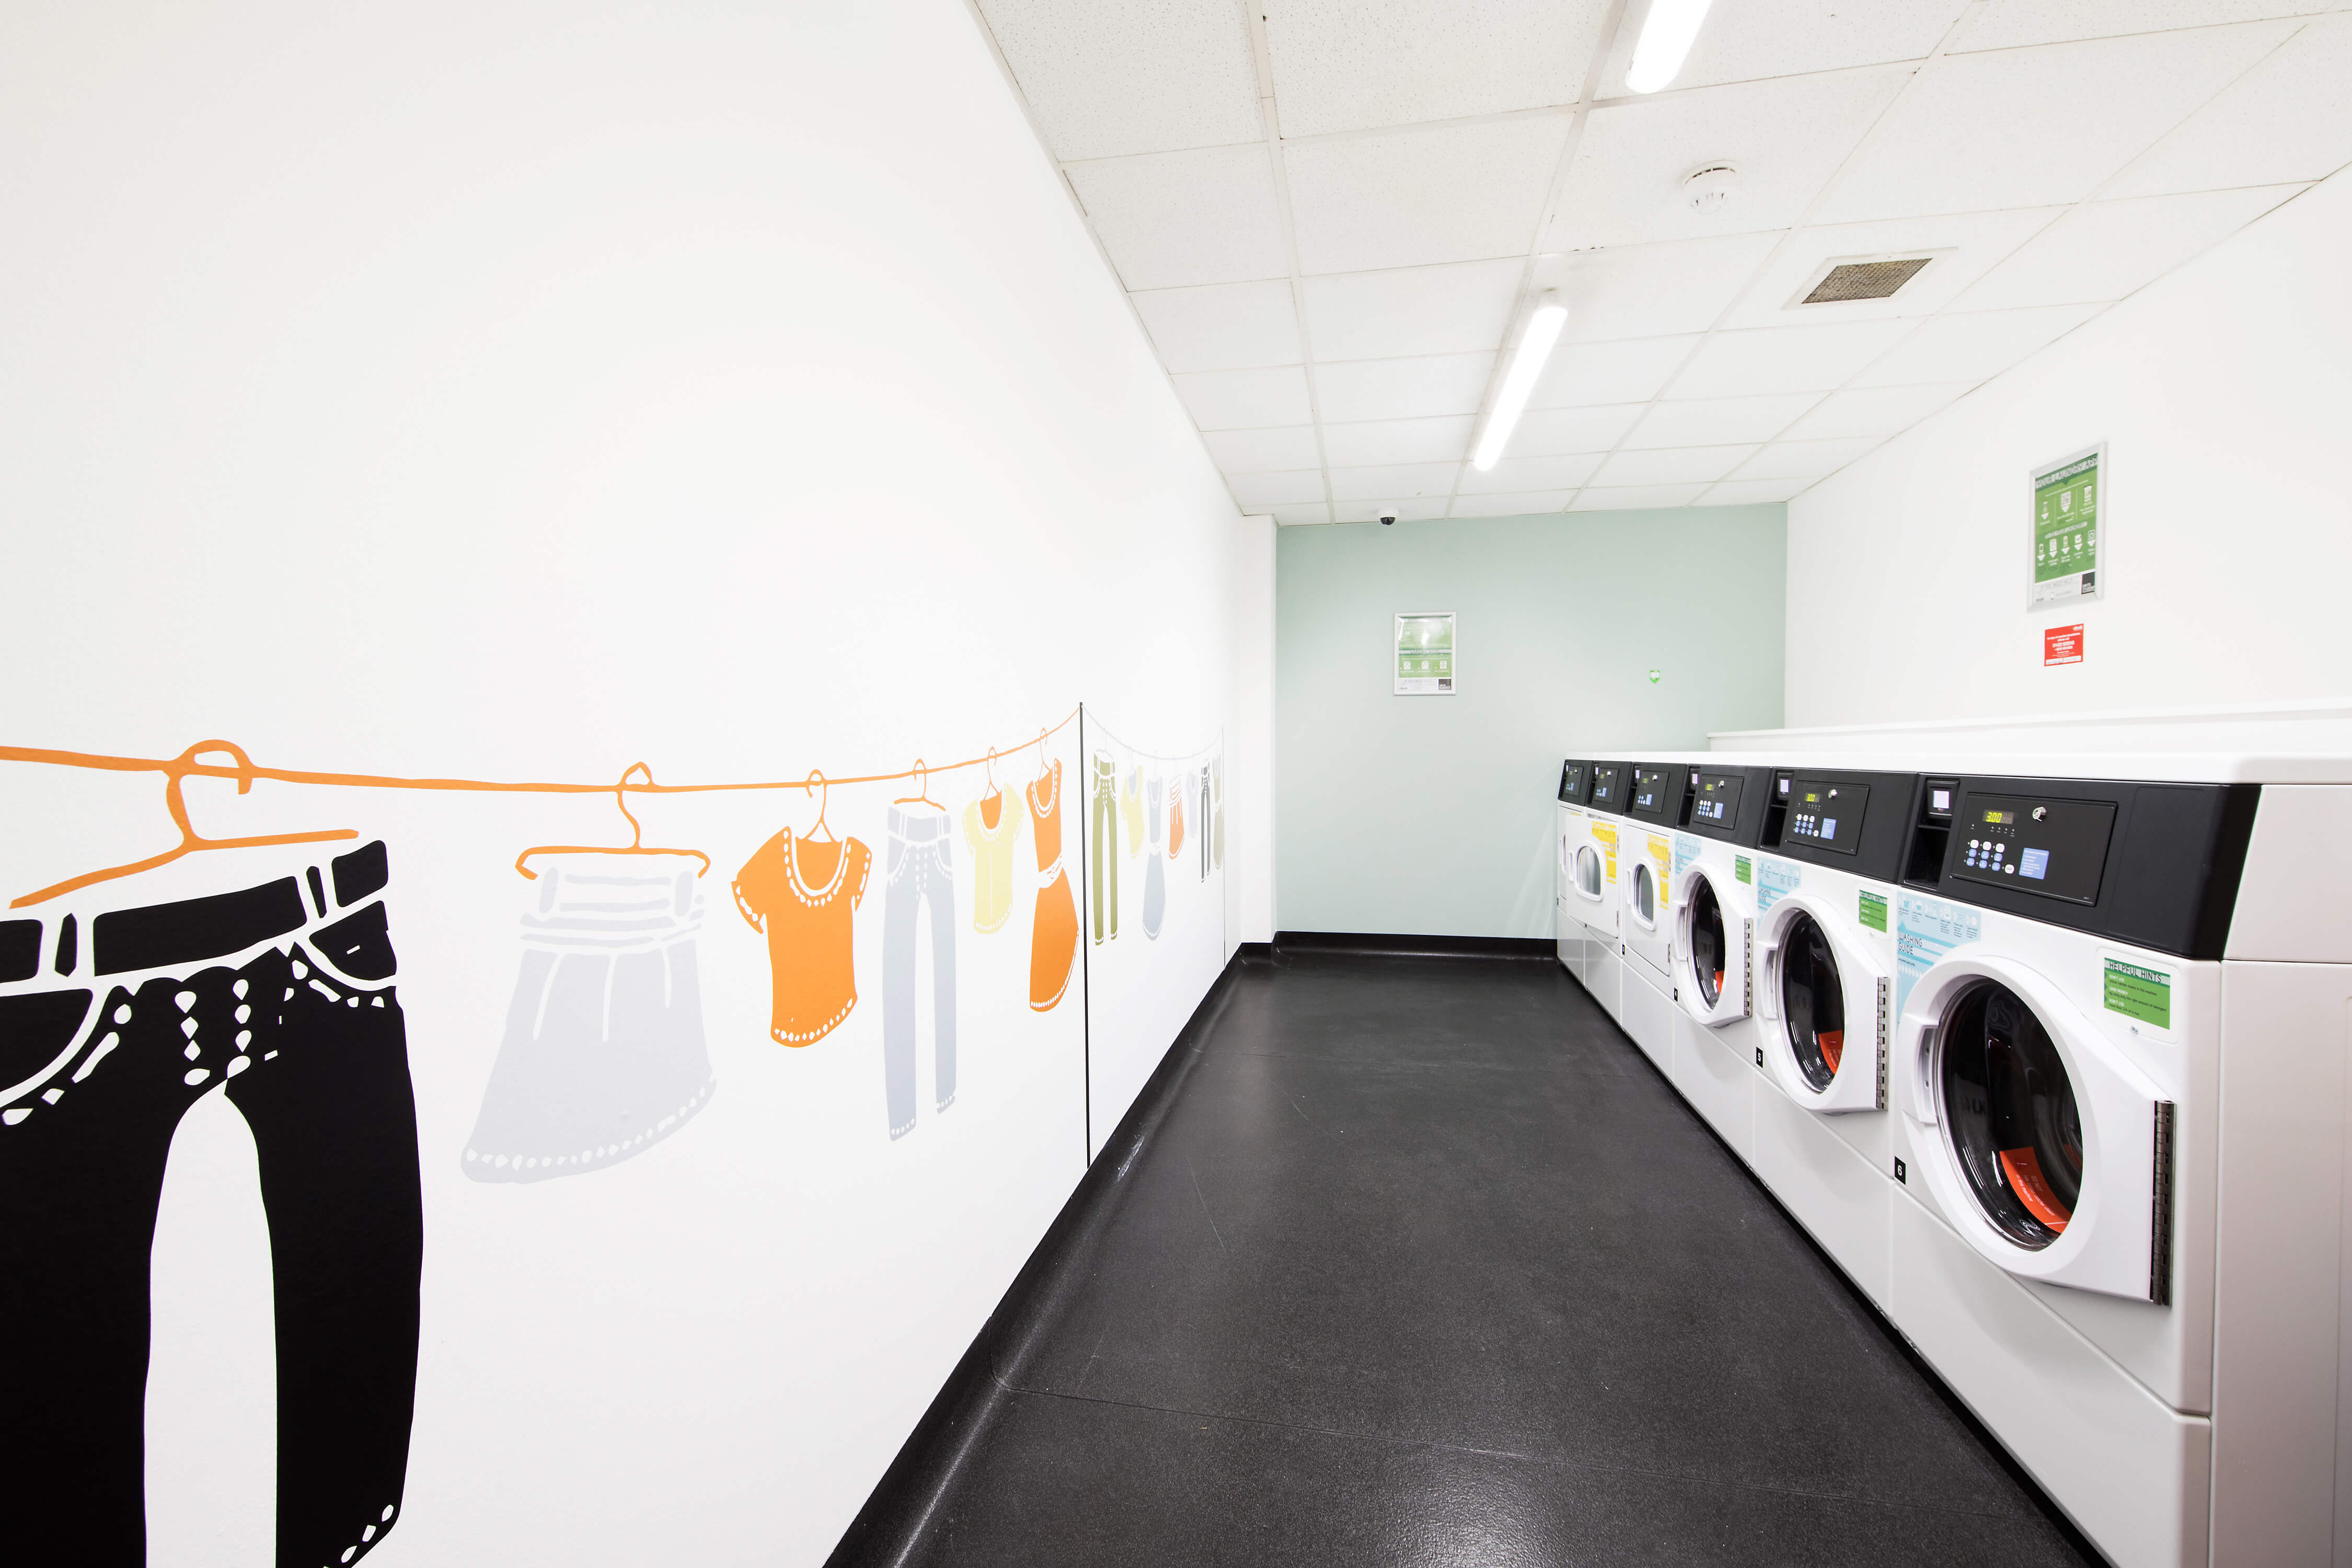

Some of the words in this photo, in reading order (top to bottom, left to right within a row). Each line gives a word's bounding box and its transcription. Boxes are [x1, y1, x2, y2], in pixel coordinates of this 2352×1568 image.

[1898, 932, 1923, 947] WASHING
[1898, 942, 1913, 954] GUIDE
[2109, 962, 2139, 977] HELPFUL
[2141, 970, 2161, 983] HINTS
[1758, 1052, 1761, 1062] 5
[1897, 1165, 1903, 1176] 6
